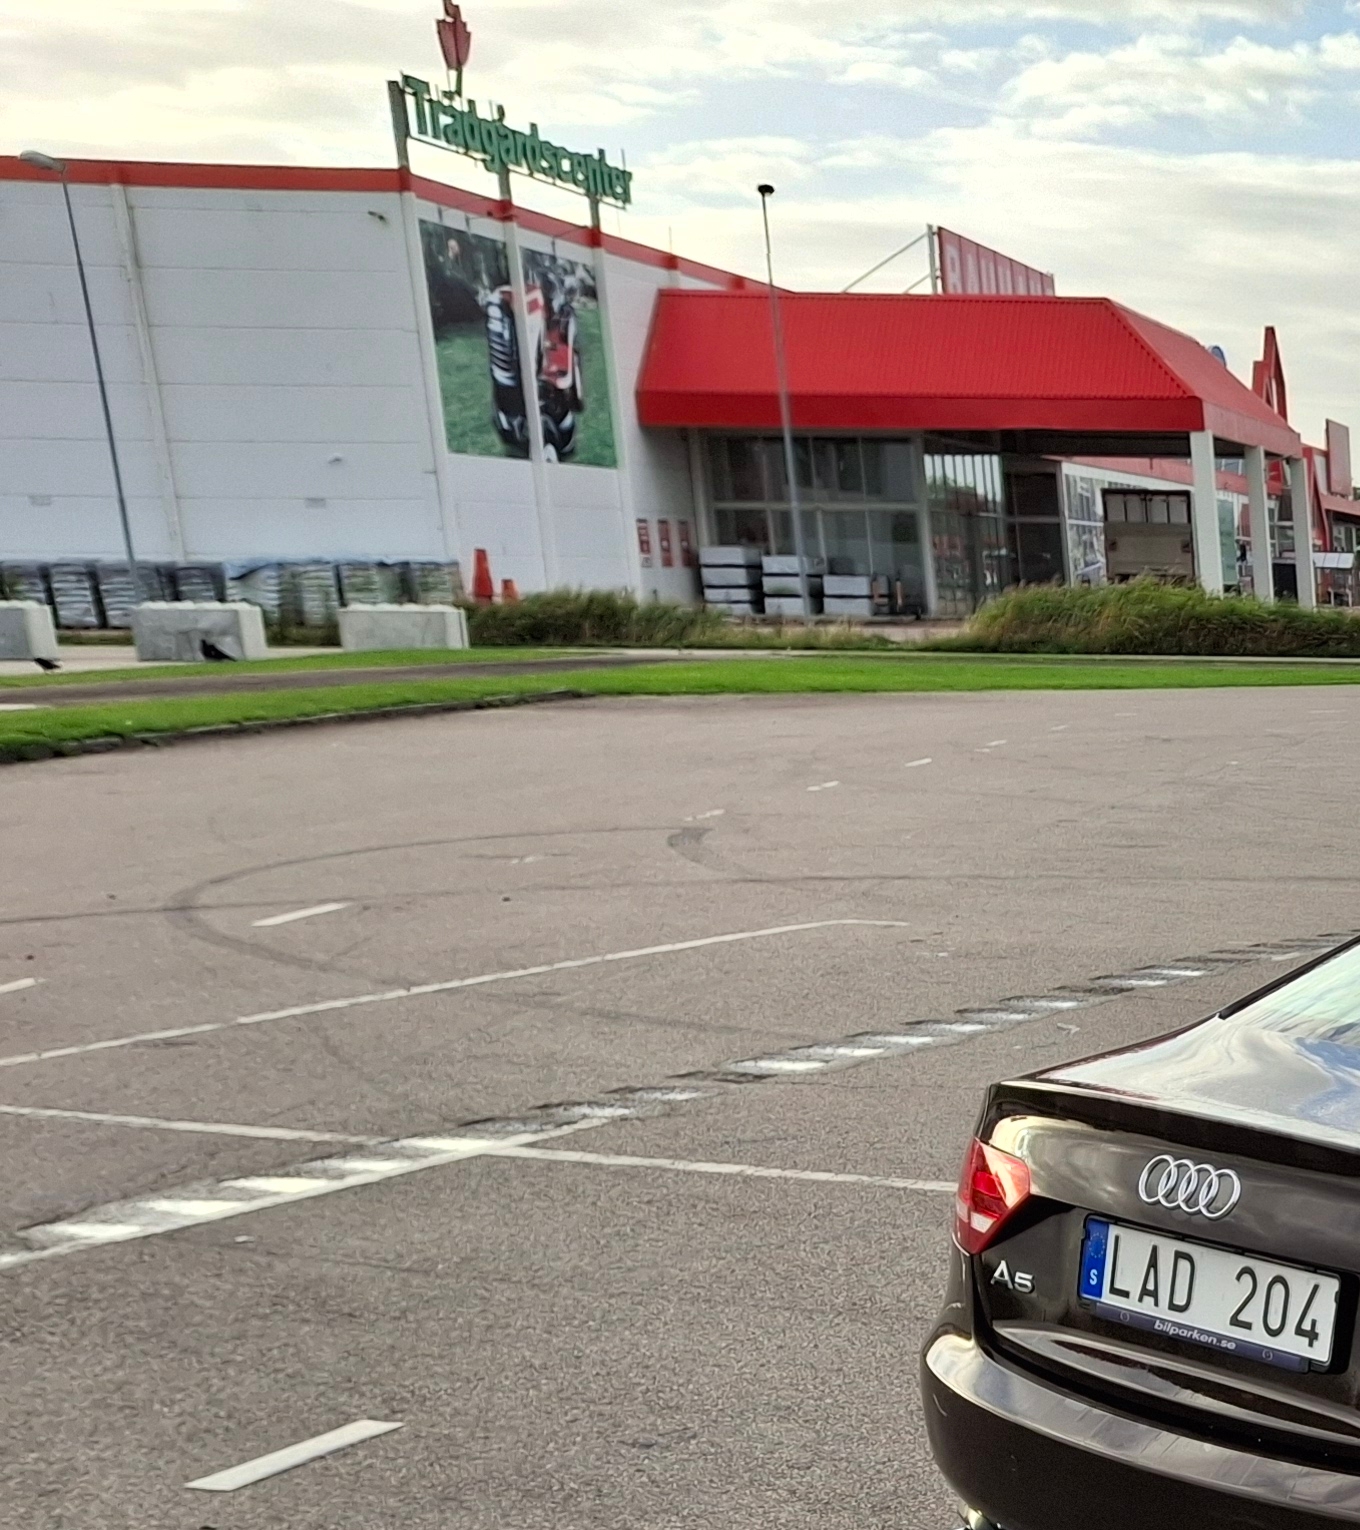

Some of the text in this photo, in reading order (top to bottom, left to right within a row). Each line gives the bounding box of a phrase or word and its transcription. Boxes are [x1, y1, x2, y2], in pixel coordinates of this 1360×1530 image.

[990, 1259, 1034, 1294] A5
[1089, 1268, 1098, 1286] S
[1108, 1234, 1320, 1348] LAD 204
[1153, 1319, 1237, 1351] bilparken.se
